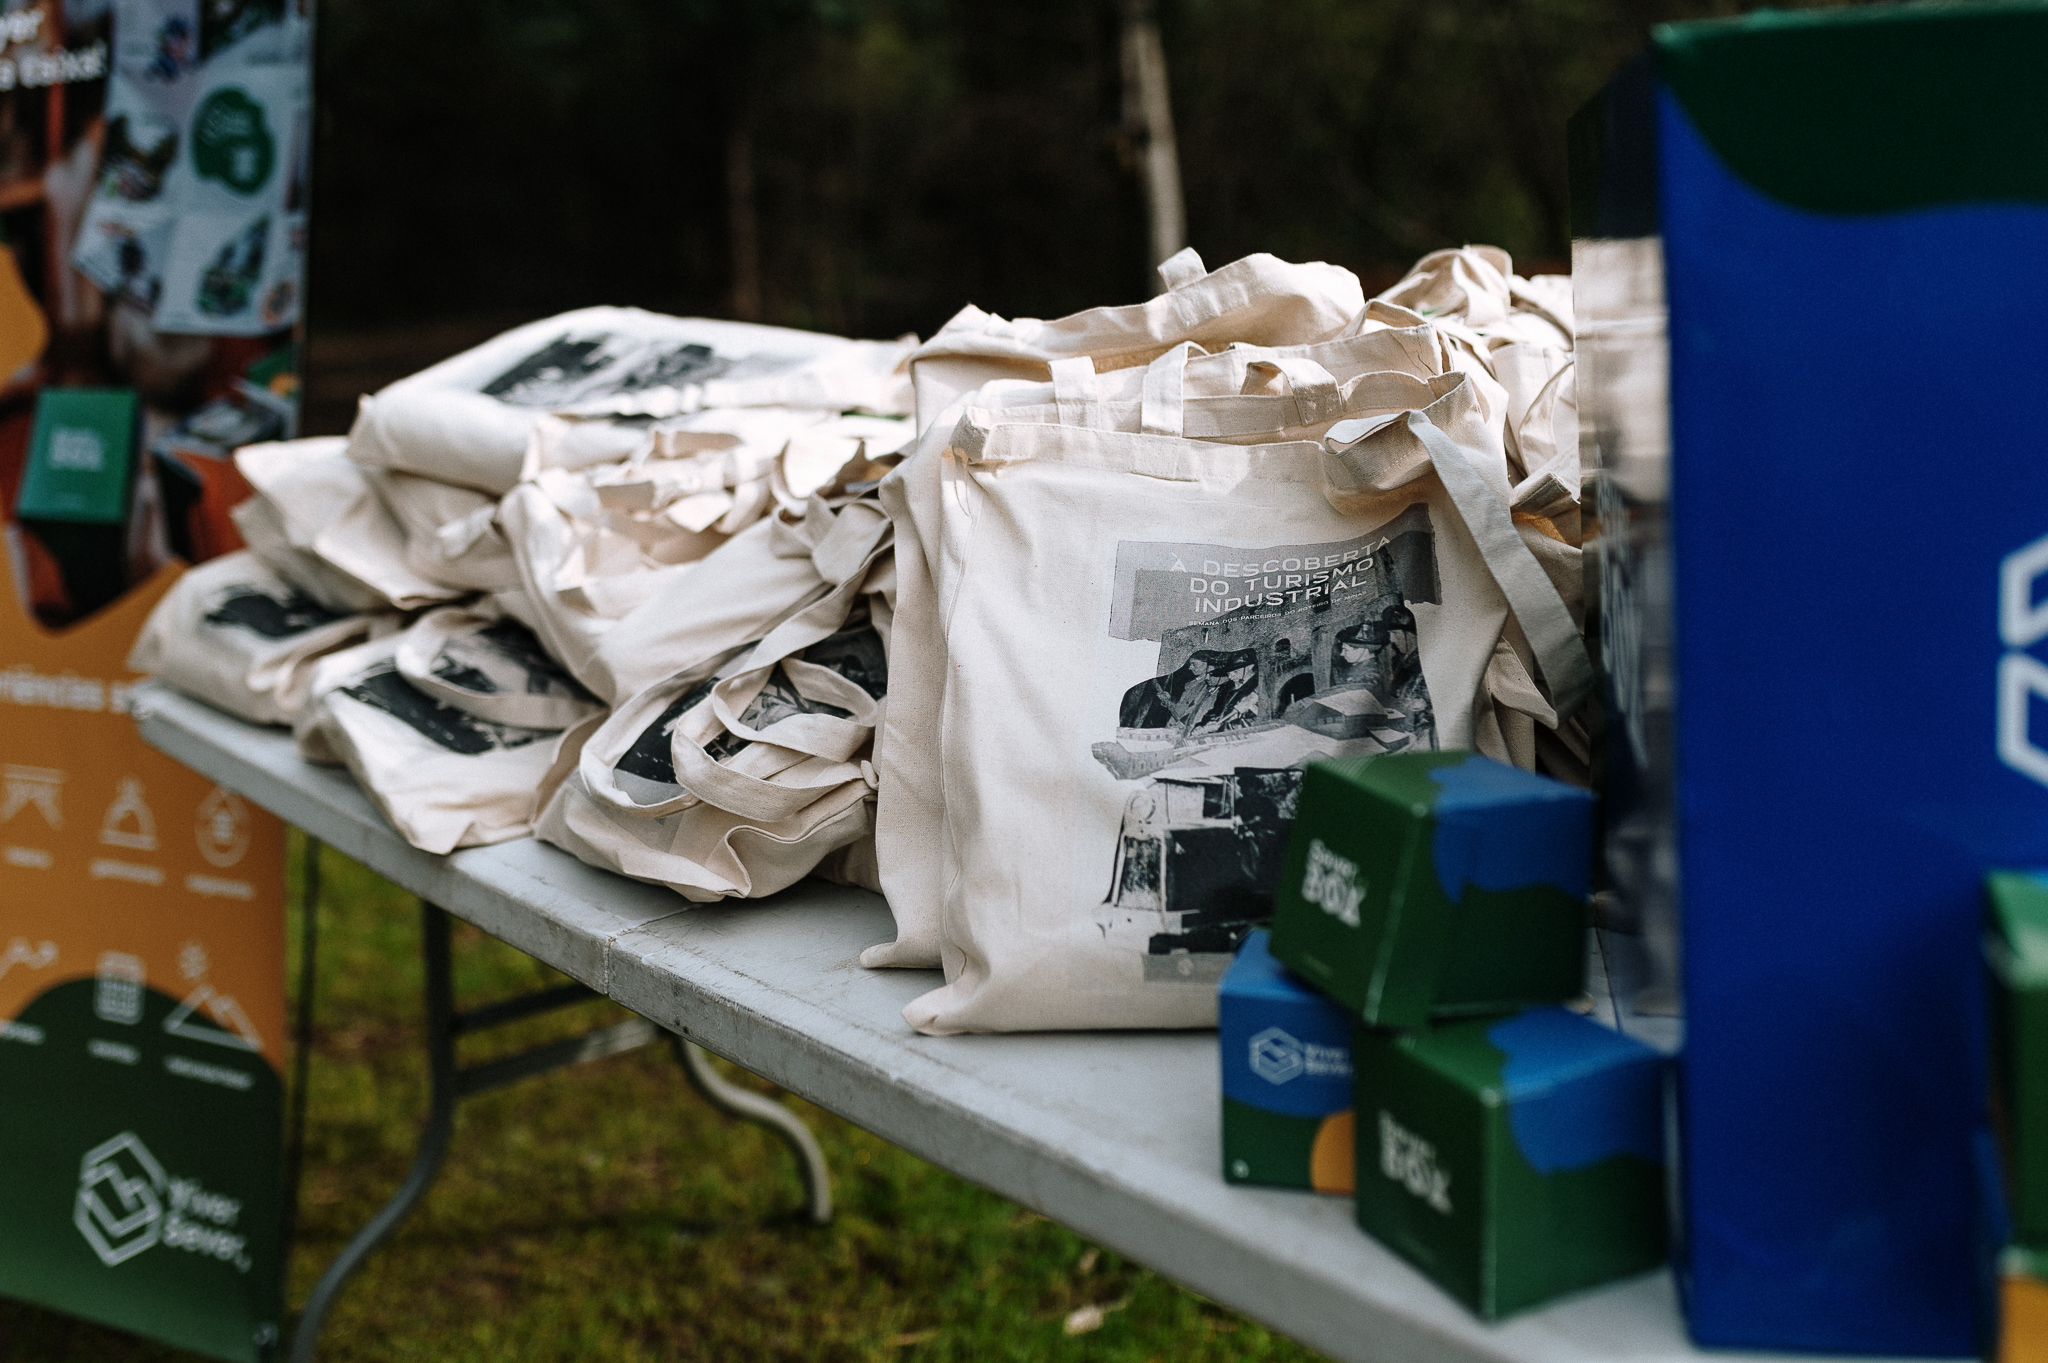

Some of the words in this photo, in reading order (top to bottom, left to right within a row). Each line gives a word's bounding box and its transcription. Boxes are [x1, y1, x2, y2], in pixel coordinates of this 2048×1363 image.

[1203, 536, 1391, 578] DESCOBERTA
[1190, 577, 1230, 595] DO
[1244, 558, 1375, 592] TURISMO
[1195, 576, 1367, 613] INDUSTRIAL
